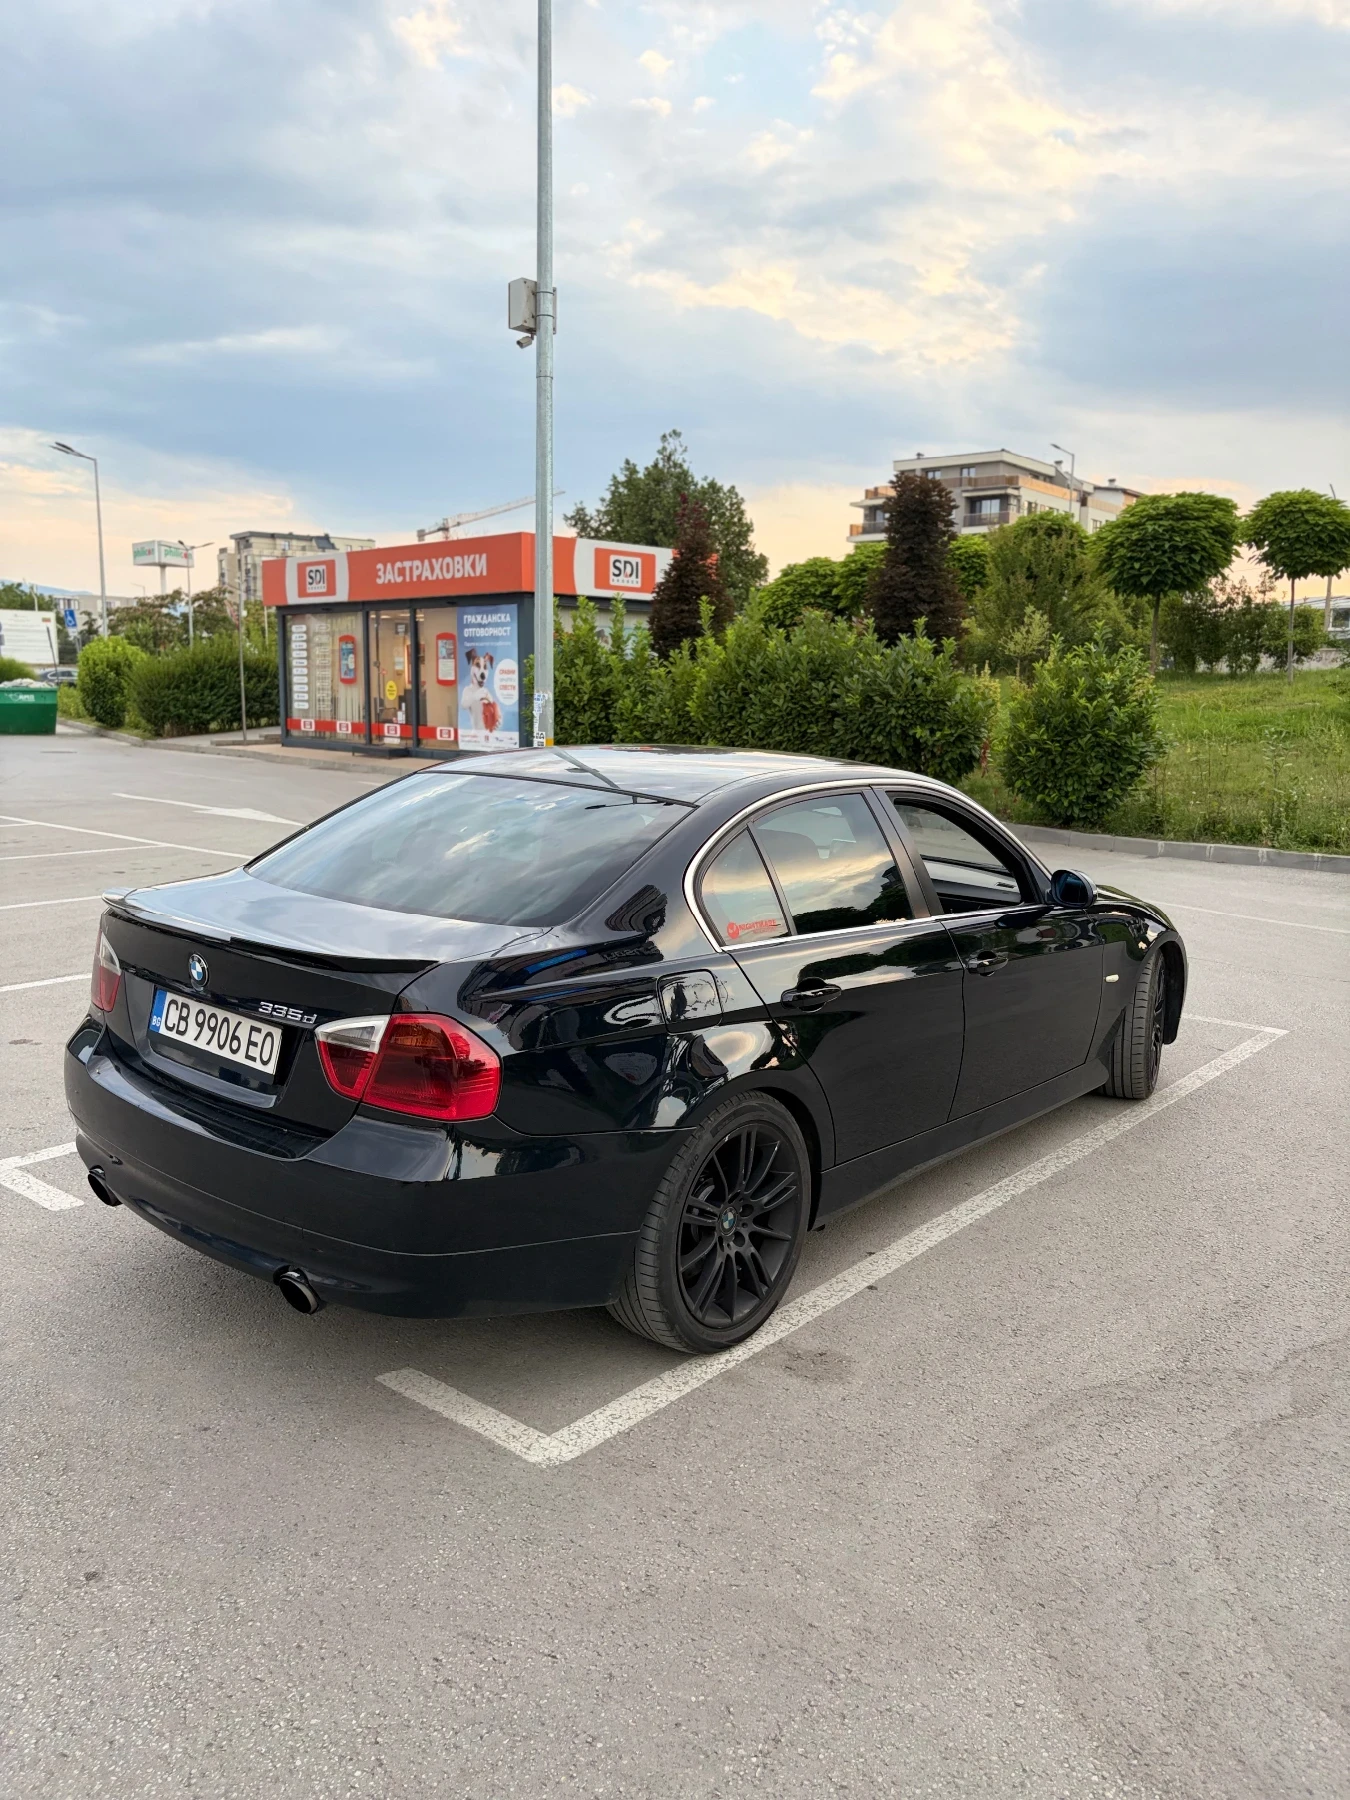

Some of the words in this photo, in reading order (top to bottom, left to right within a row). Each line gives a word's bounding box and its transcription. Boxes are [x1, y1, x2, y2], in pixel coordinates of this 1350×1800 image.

[308, 568, 325, 585] SDI
[376, 553, 487, 584] ЗАСТРАХОВКИ
[612, 559, 639, 579] SDI
[463, 613, 511, 625] ГРАЖДАНСКА
[463, 627, 511, 637] ОТГОВОРНОСТ
[151, 1015, 161, 1027] BG
[258, 1001, 317, 1024] 335d
[164, 999, 190, 1036] CB
[193, 1008, 242, 1055] 9906
